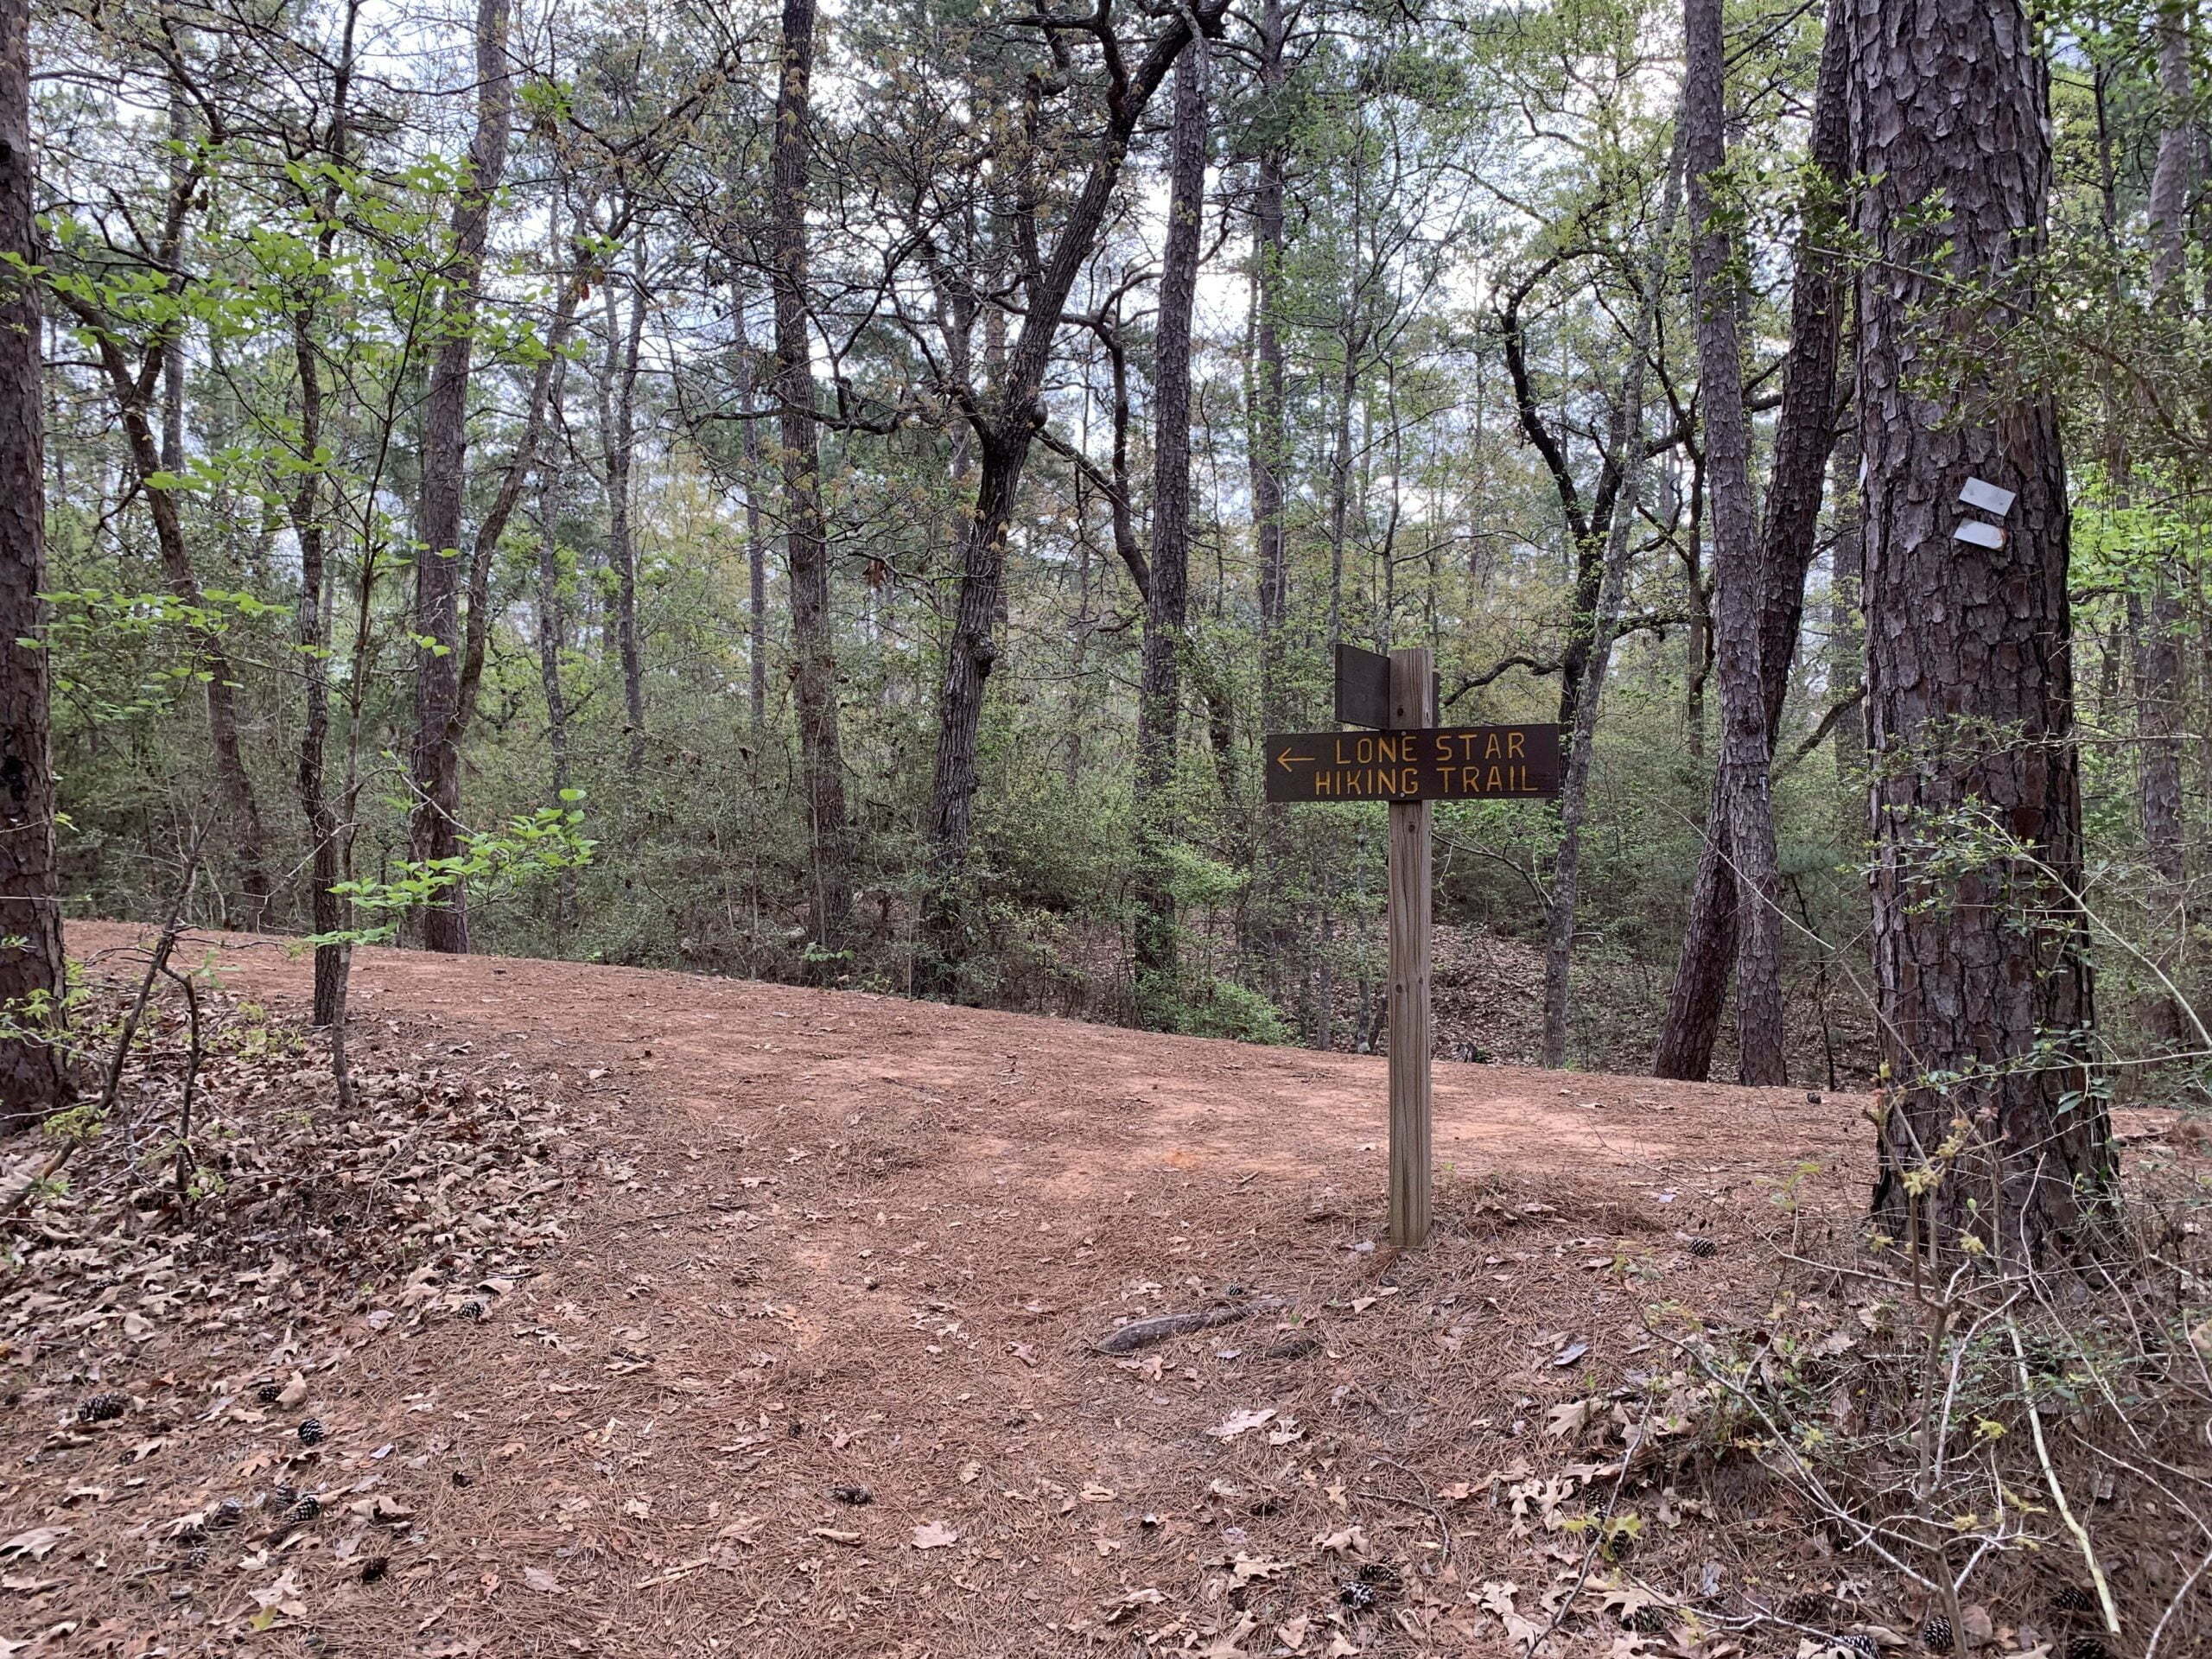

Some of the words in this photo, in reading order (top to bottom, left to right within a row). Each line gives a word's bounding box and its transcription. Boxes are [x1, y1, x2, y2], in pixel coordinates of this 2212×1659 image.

[1335, 736, 1418, 765] LONE
[1435, 732, 1526, 761] STAR
[1315, 767, 1419, 796] HIKING
[1436, 765, 1538, 792] TRAIL
